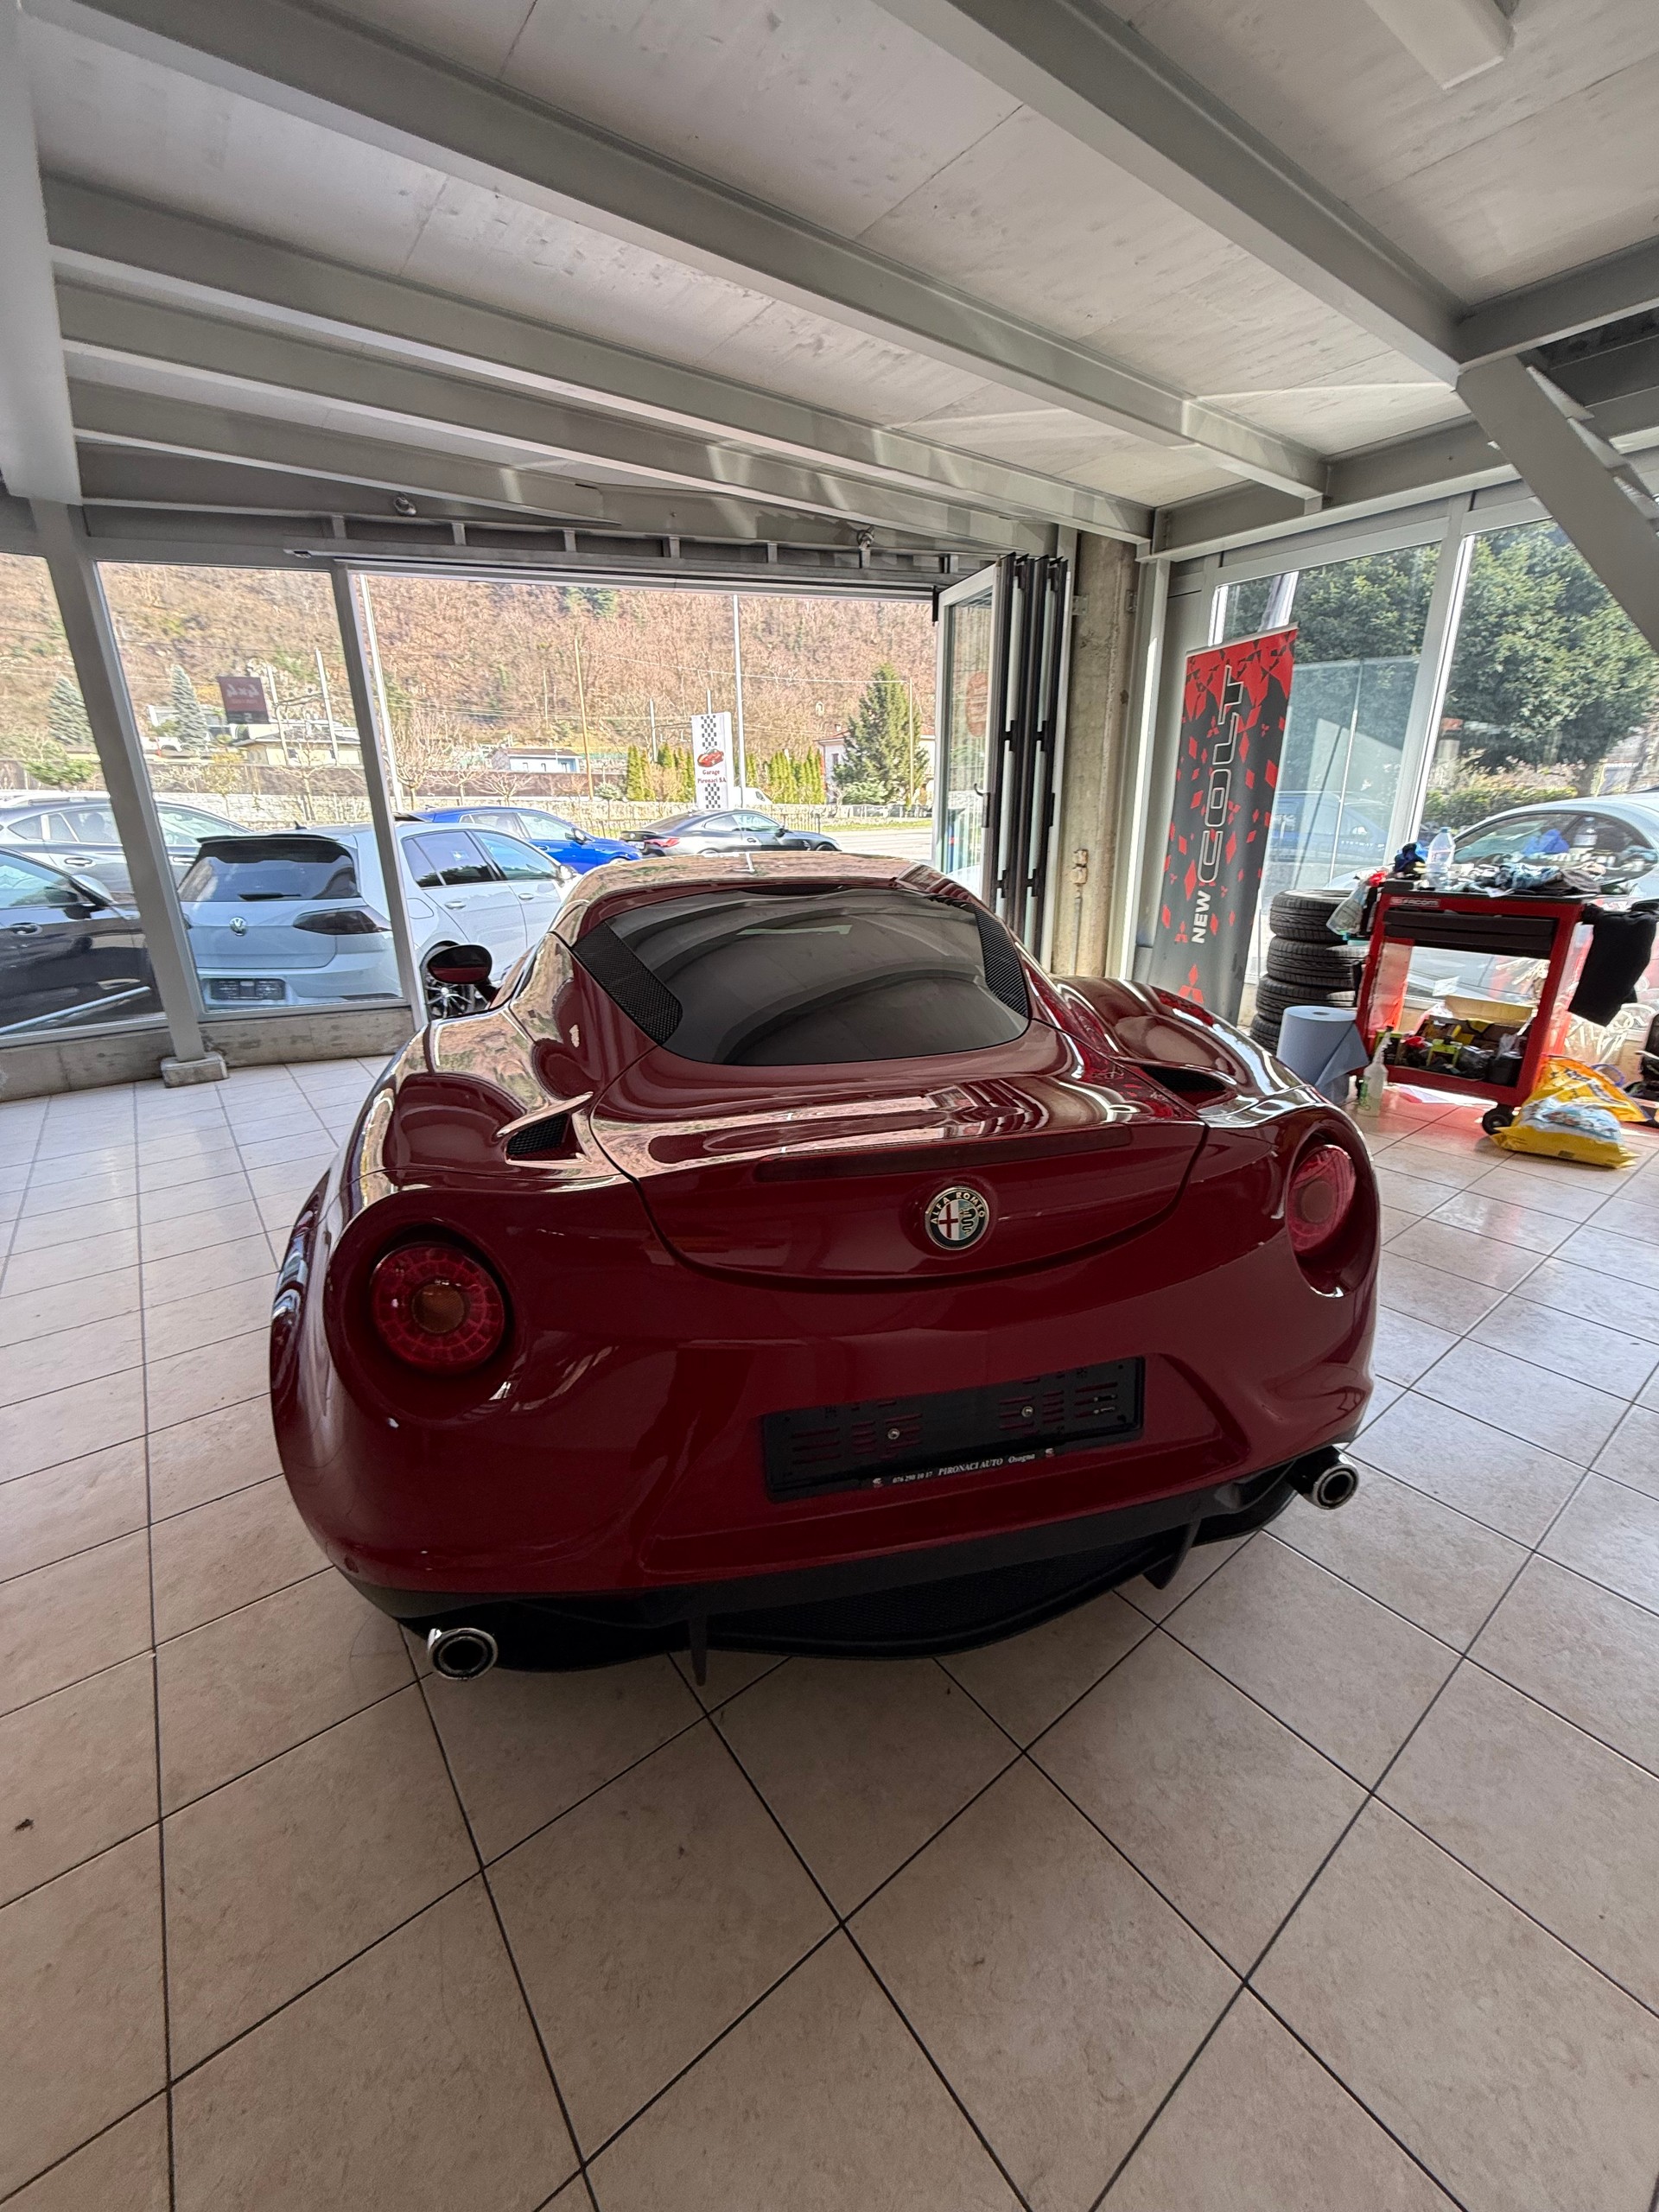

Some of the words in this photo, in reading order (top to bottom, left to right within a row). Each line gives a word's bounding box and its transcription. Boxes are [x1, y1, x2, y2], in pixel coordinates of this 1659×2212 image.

[1198, 664, 1244, 882] COLT
[1192, 890, 1211, 944] NEW
[930, 1197, 950, 1224] ALFA
[956, 1192, 986, 1217] ROMEO
[938, 1462, 979, 1476] PIRONACI
[979, 1458, 1004, 1469] AUTO
